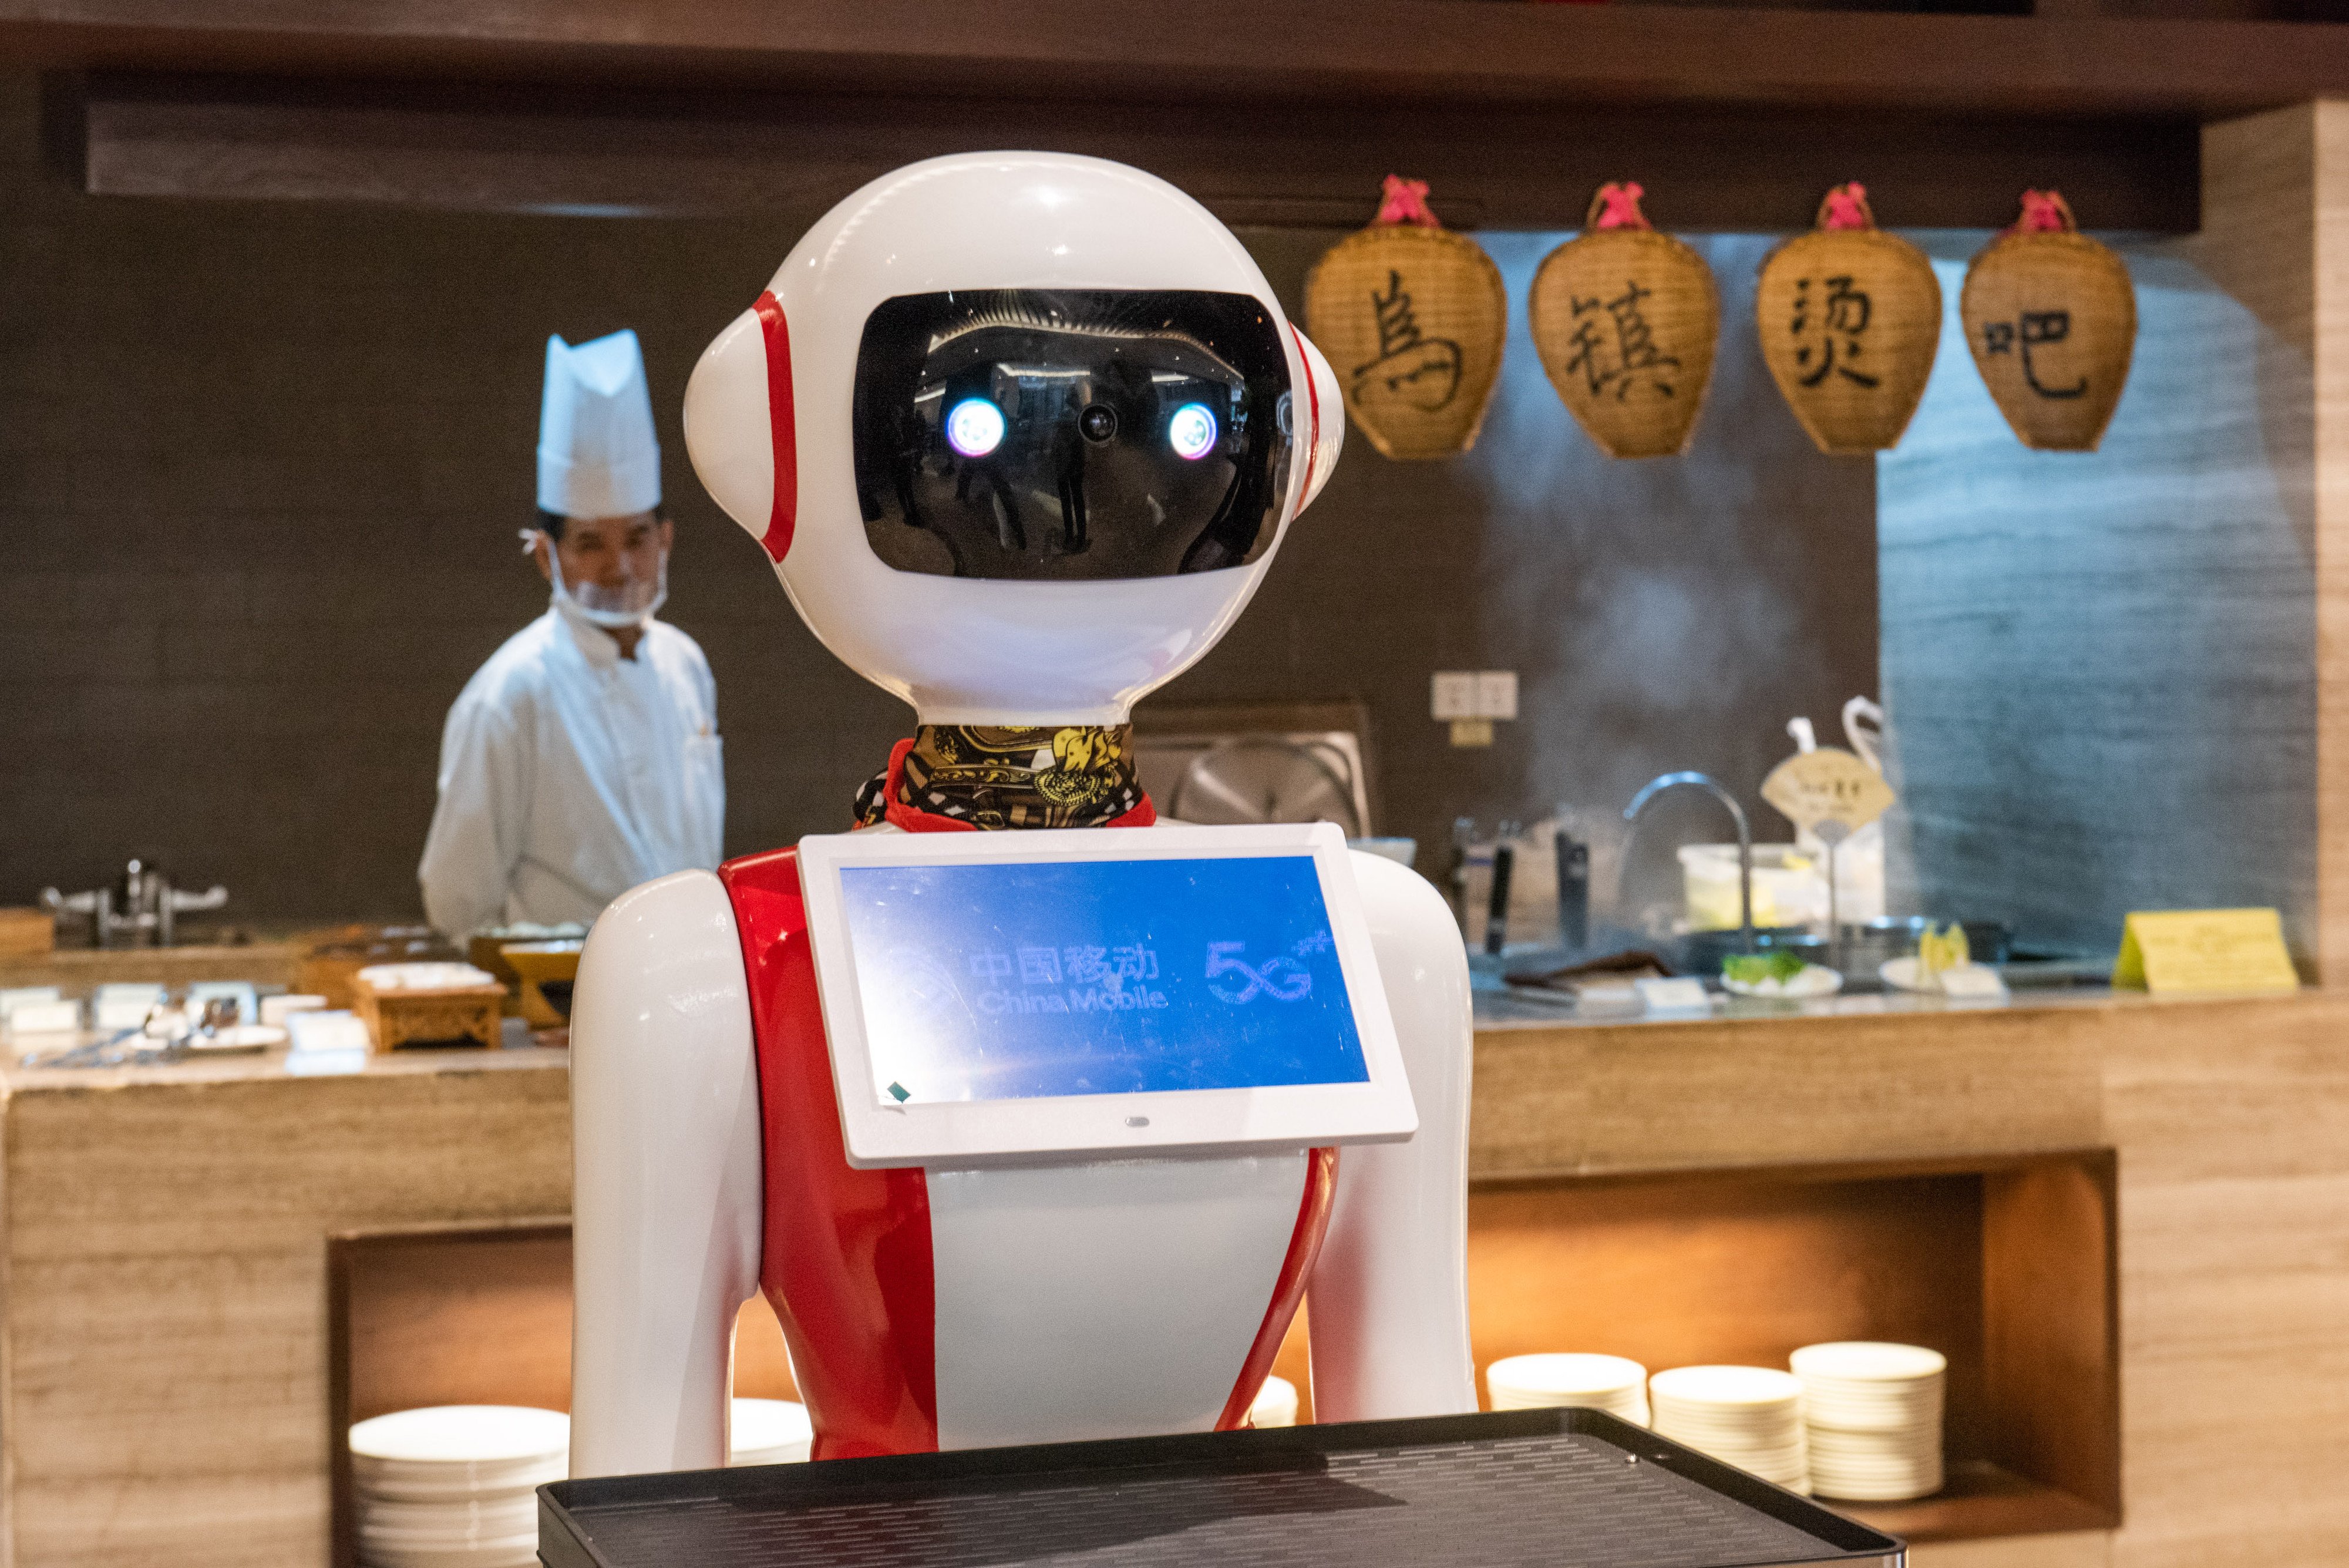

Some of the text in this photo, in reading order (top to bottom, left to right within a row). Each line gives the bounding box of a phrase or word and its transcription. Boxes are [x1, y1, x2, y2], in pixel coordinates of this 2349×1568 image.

[1984, 310, 2088, 399] 吧
[970, 943, 1159, 985] 中国移动
[977, 984, 1168, 1014] China Mobile
